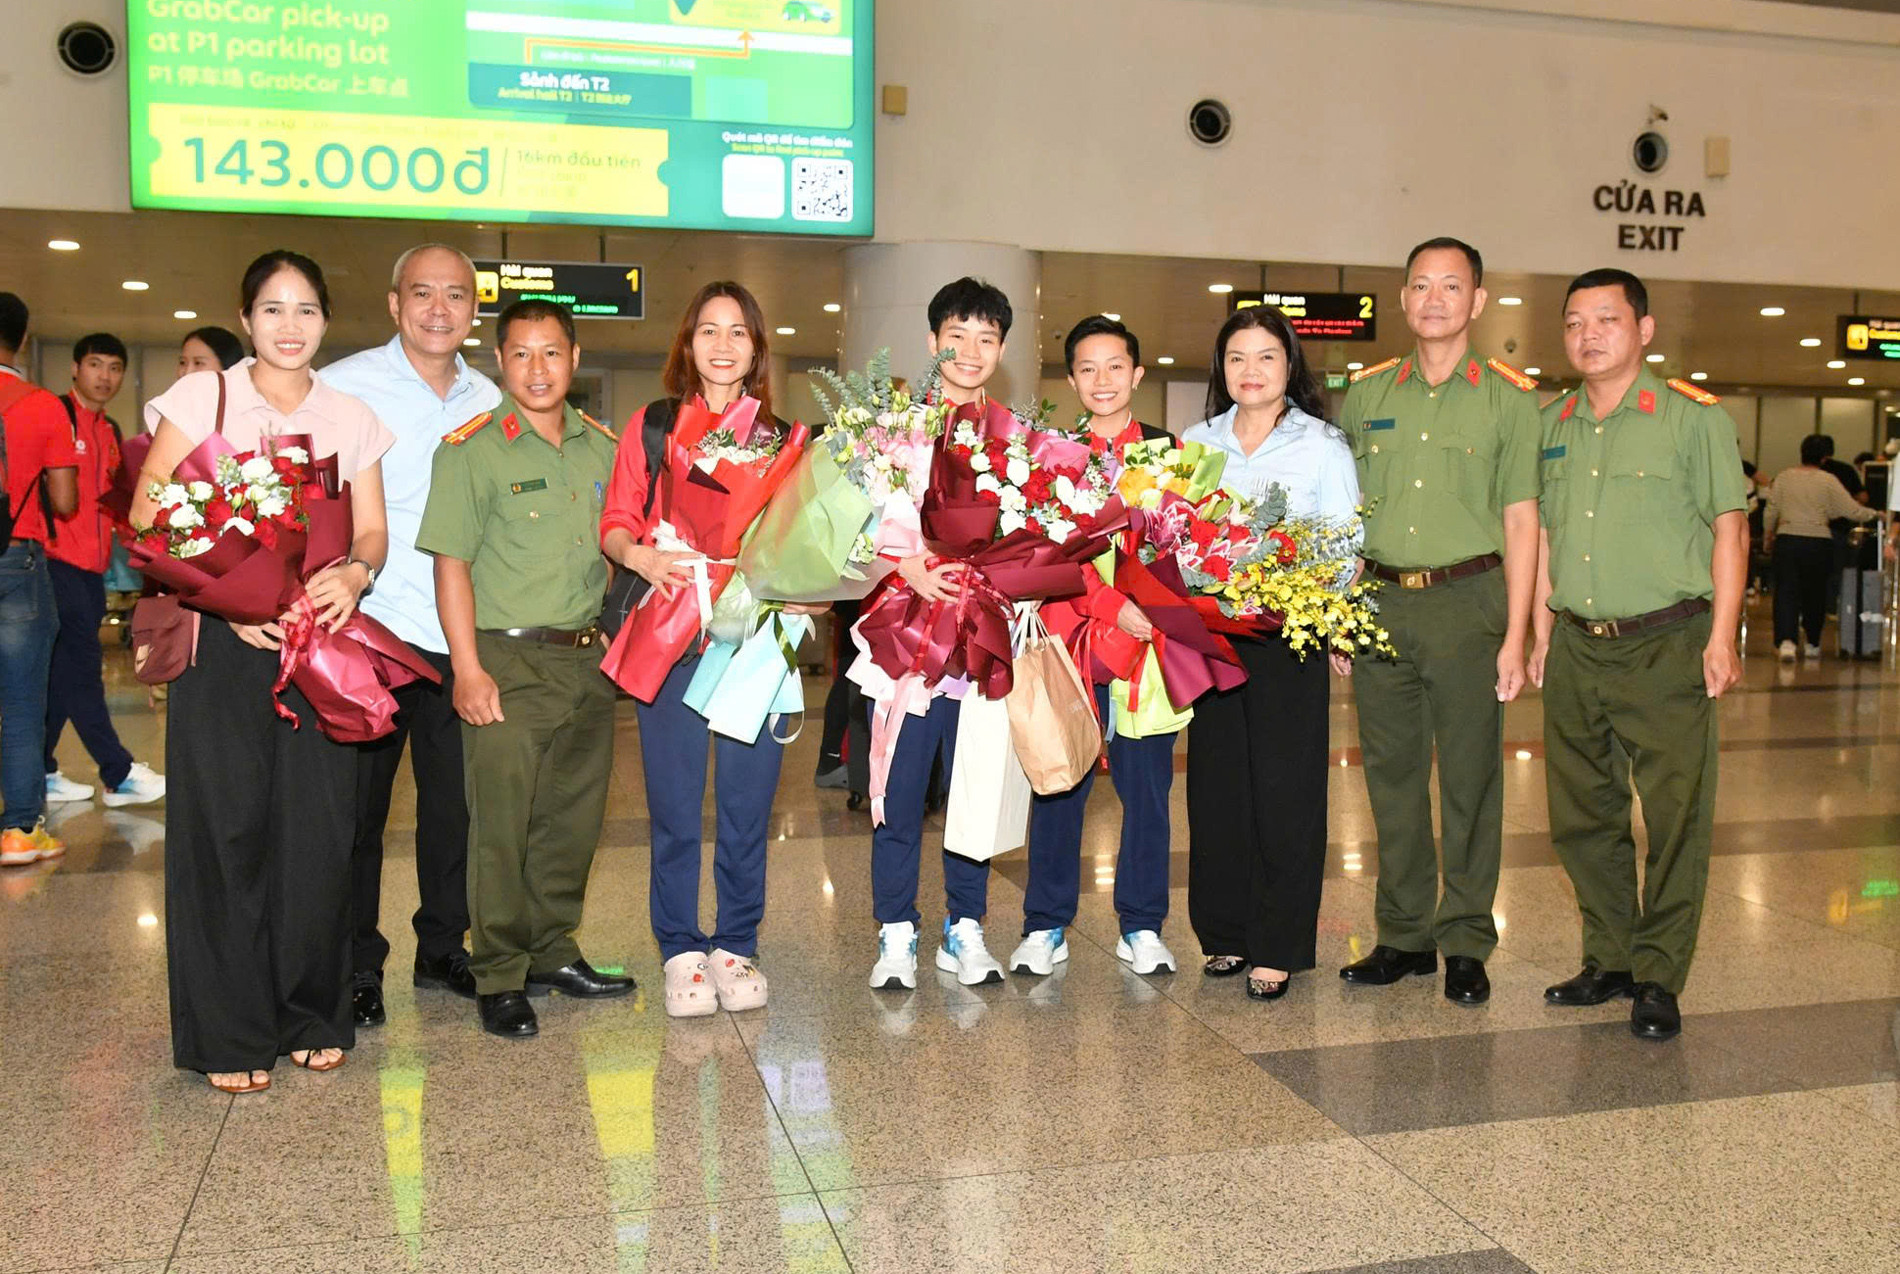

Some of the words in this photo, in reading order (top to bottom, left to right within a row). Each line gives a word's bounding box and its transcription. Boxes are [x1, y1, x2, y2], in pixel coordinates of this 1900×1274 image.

[147, 0, 275, 24] GrabCar
[280, 2, 390, 38] pick-up
[147, 31, 181, 54] at
[187, 31, 219, 55] P1
[226, 34, 342, 69] parking
[348, 38, 390, 66] lot
[147, 65, 173, 86] P1
[248, 70, 341, 93] GrabCar
[590, 75, 610, 92] T2
[184, 136, 490, 196] 143.000đ
[1592, 179, 1656, 215] CỬA
[1664, 190, 1706, 217] RA
[1617, 223, 1685, 252] EXIT
[625, 268, 640, 293] 1
[1358, 295, 1374, 319] 2
